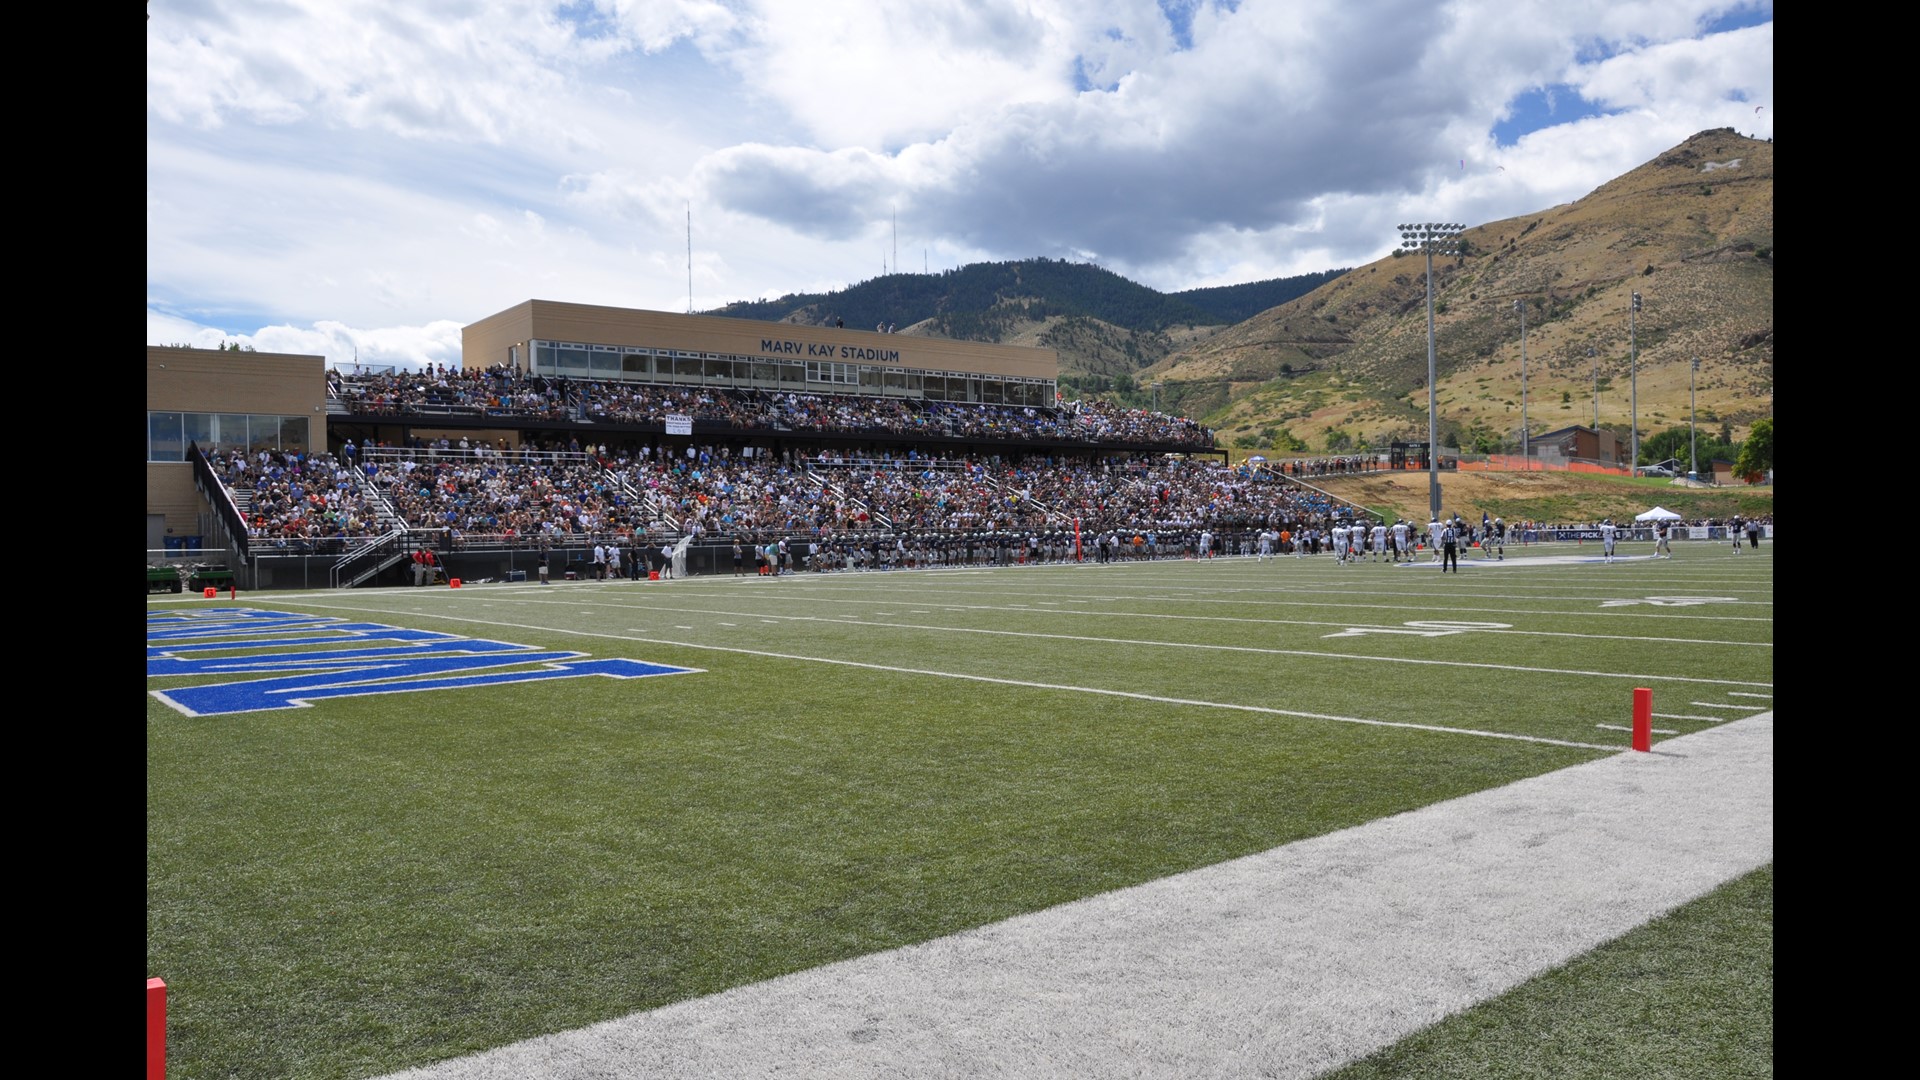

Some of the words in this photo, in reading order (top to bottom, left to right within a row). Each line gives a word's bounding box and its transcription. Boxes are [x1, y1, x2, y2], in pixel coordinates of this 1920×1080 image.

[761, 340, 802, 354] MARV
[808, 344, 836, 357] KAY
[841, 347, 899, 362] STADIUM
